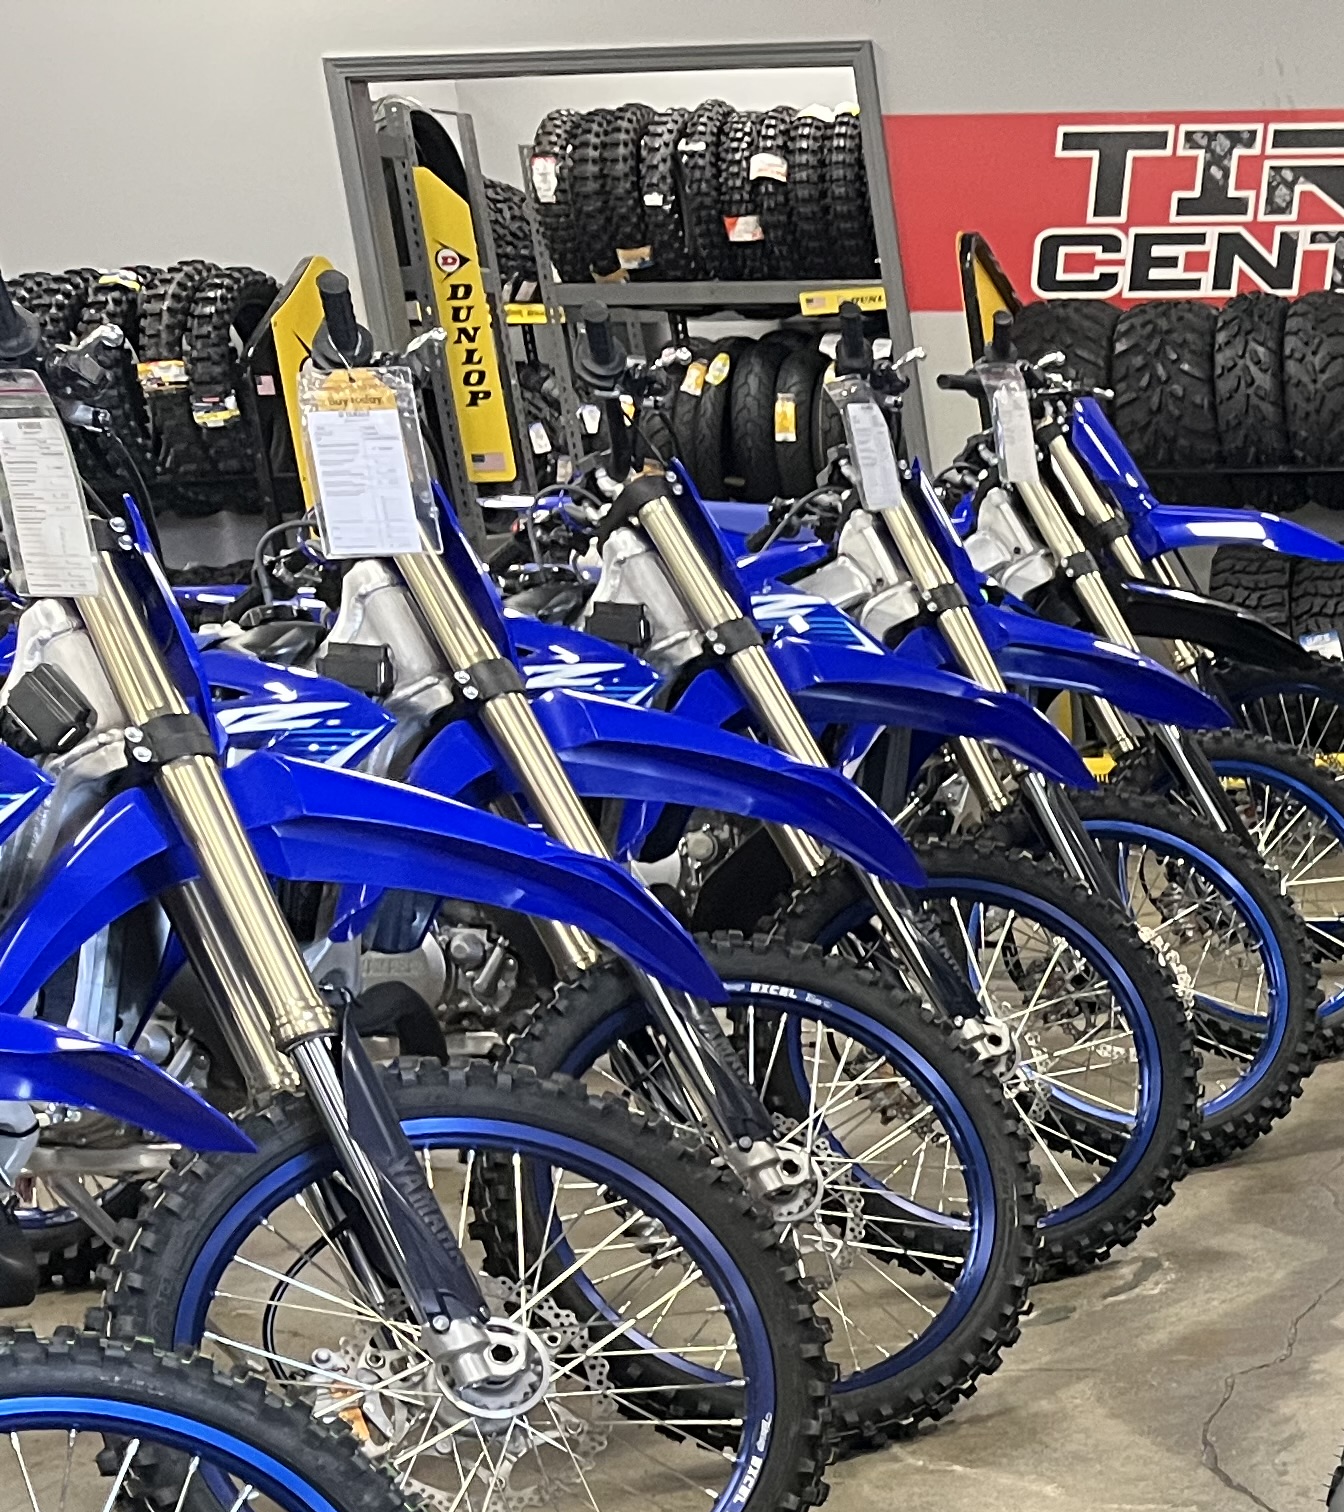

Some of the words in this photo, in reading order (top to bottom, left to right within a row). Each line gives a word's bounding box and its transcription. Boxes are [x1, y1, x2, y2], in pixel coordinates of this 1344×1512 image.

[447, 283, 492, 408] DUNLOP
[750, 982, 798, 999] EXCEL
[732, 1455, 763, 1504] EXCEL
